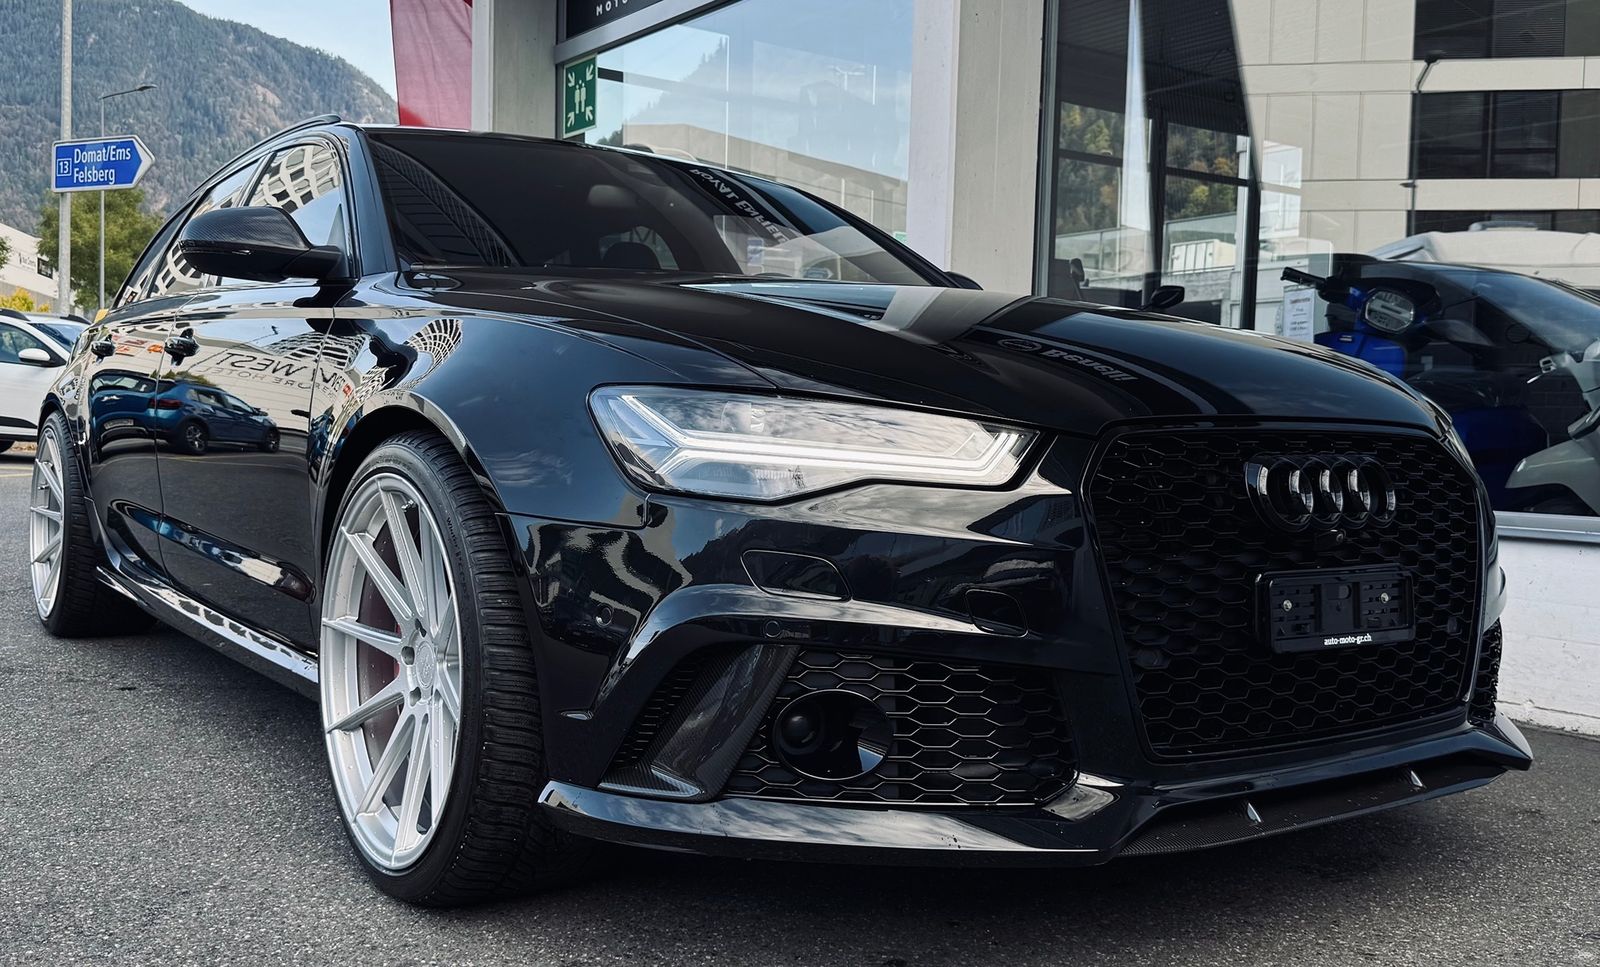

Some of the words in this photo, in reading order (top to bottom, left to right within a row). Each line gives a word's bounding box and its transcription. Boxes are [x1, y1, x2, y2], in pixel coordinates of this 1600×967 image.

[73, 145, 131, 164] Domat/Ems
[59, 160, 70, 174] 13
[73, 166, 116, 185] Felsberg
[1324, 633, 1372, 646] auto-moto-gr.ch
